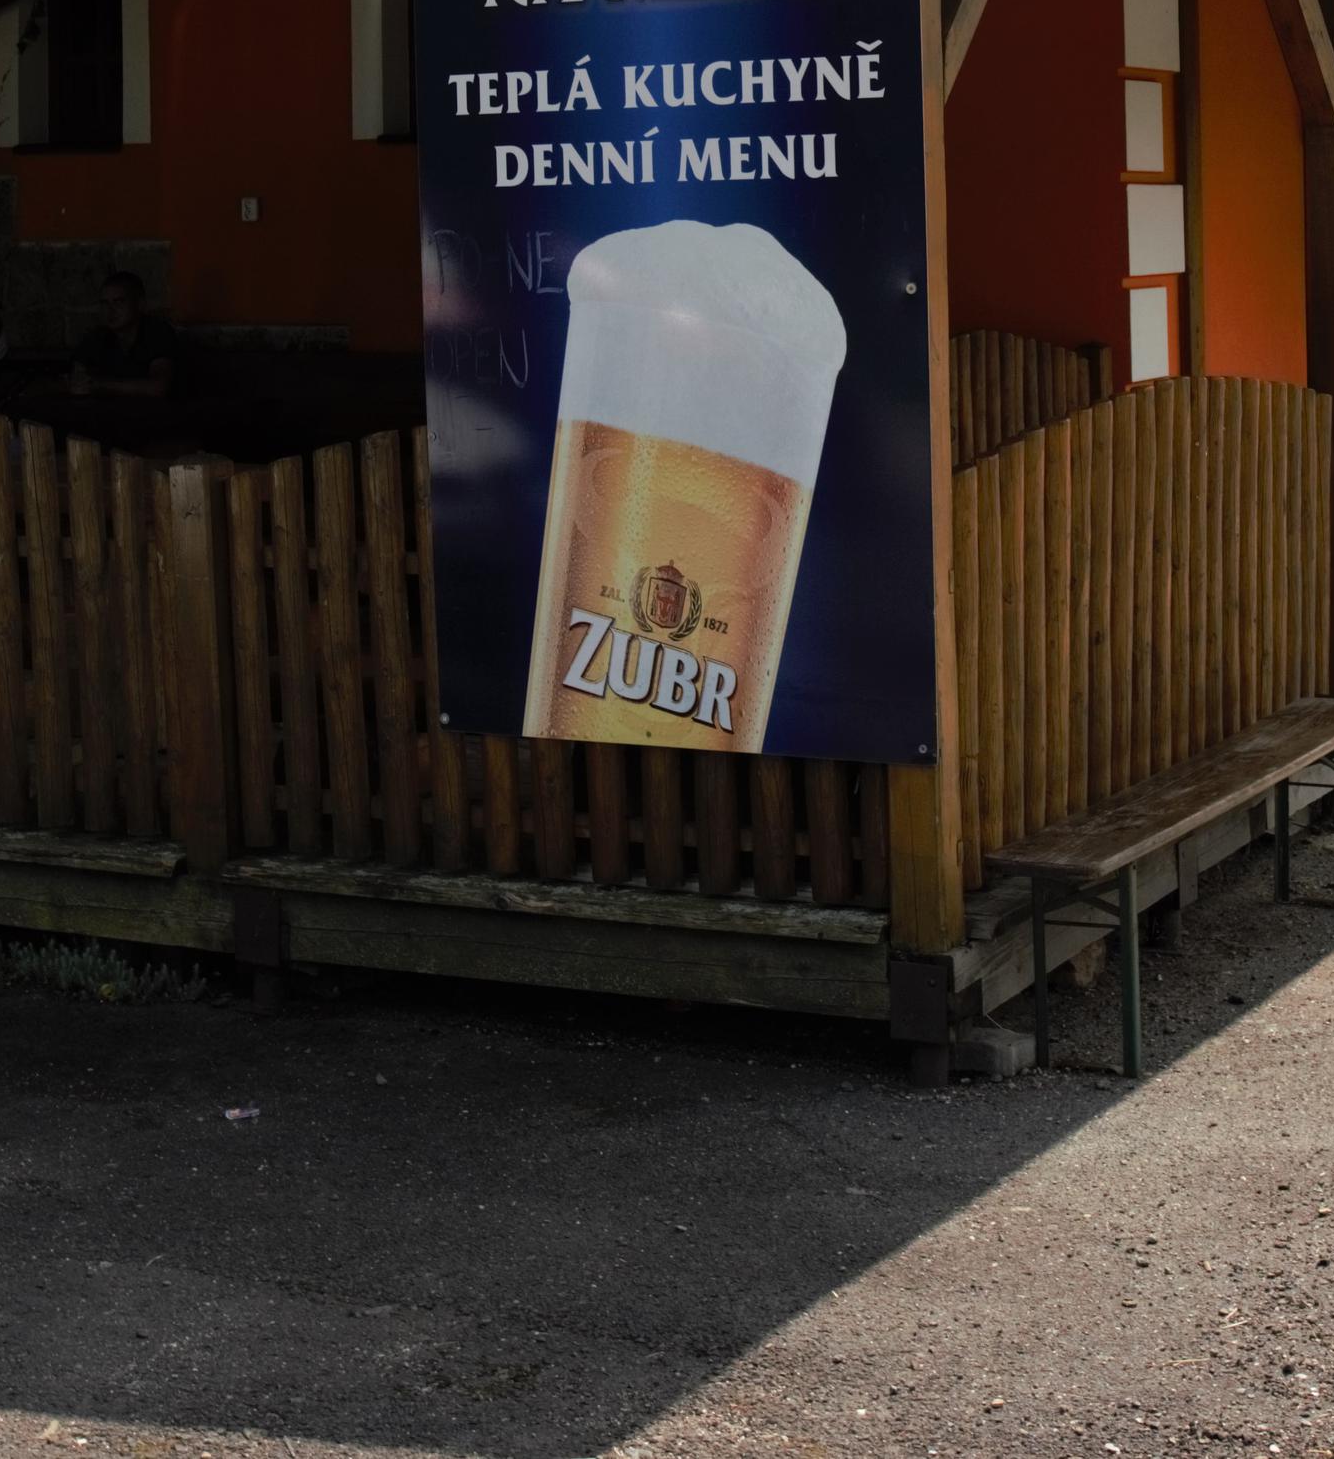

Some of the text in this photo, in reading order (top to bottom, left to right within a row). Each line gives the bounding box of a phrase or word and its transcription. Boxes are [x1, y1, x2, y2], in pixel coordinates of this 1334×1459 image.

[448, 39, 886, 116] TEPLÁ KUCHYNĚ
[494, 126, 839, 188] DENNÍ MENU
[600, 585, 730, 635] ZAL. 1872
[562, 607, 737, 734] ZUBR
